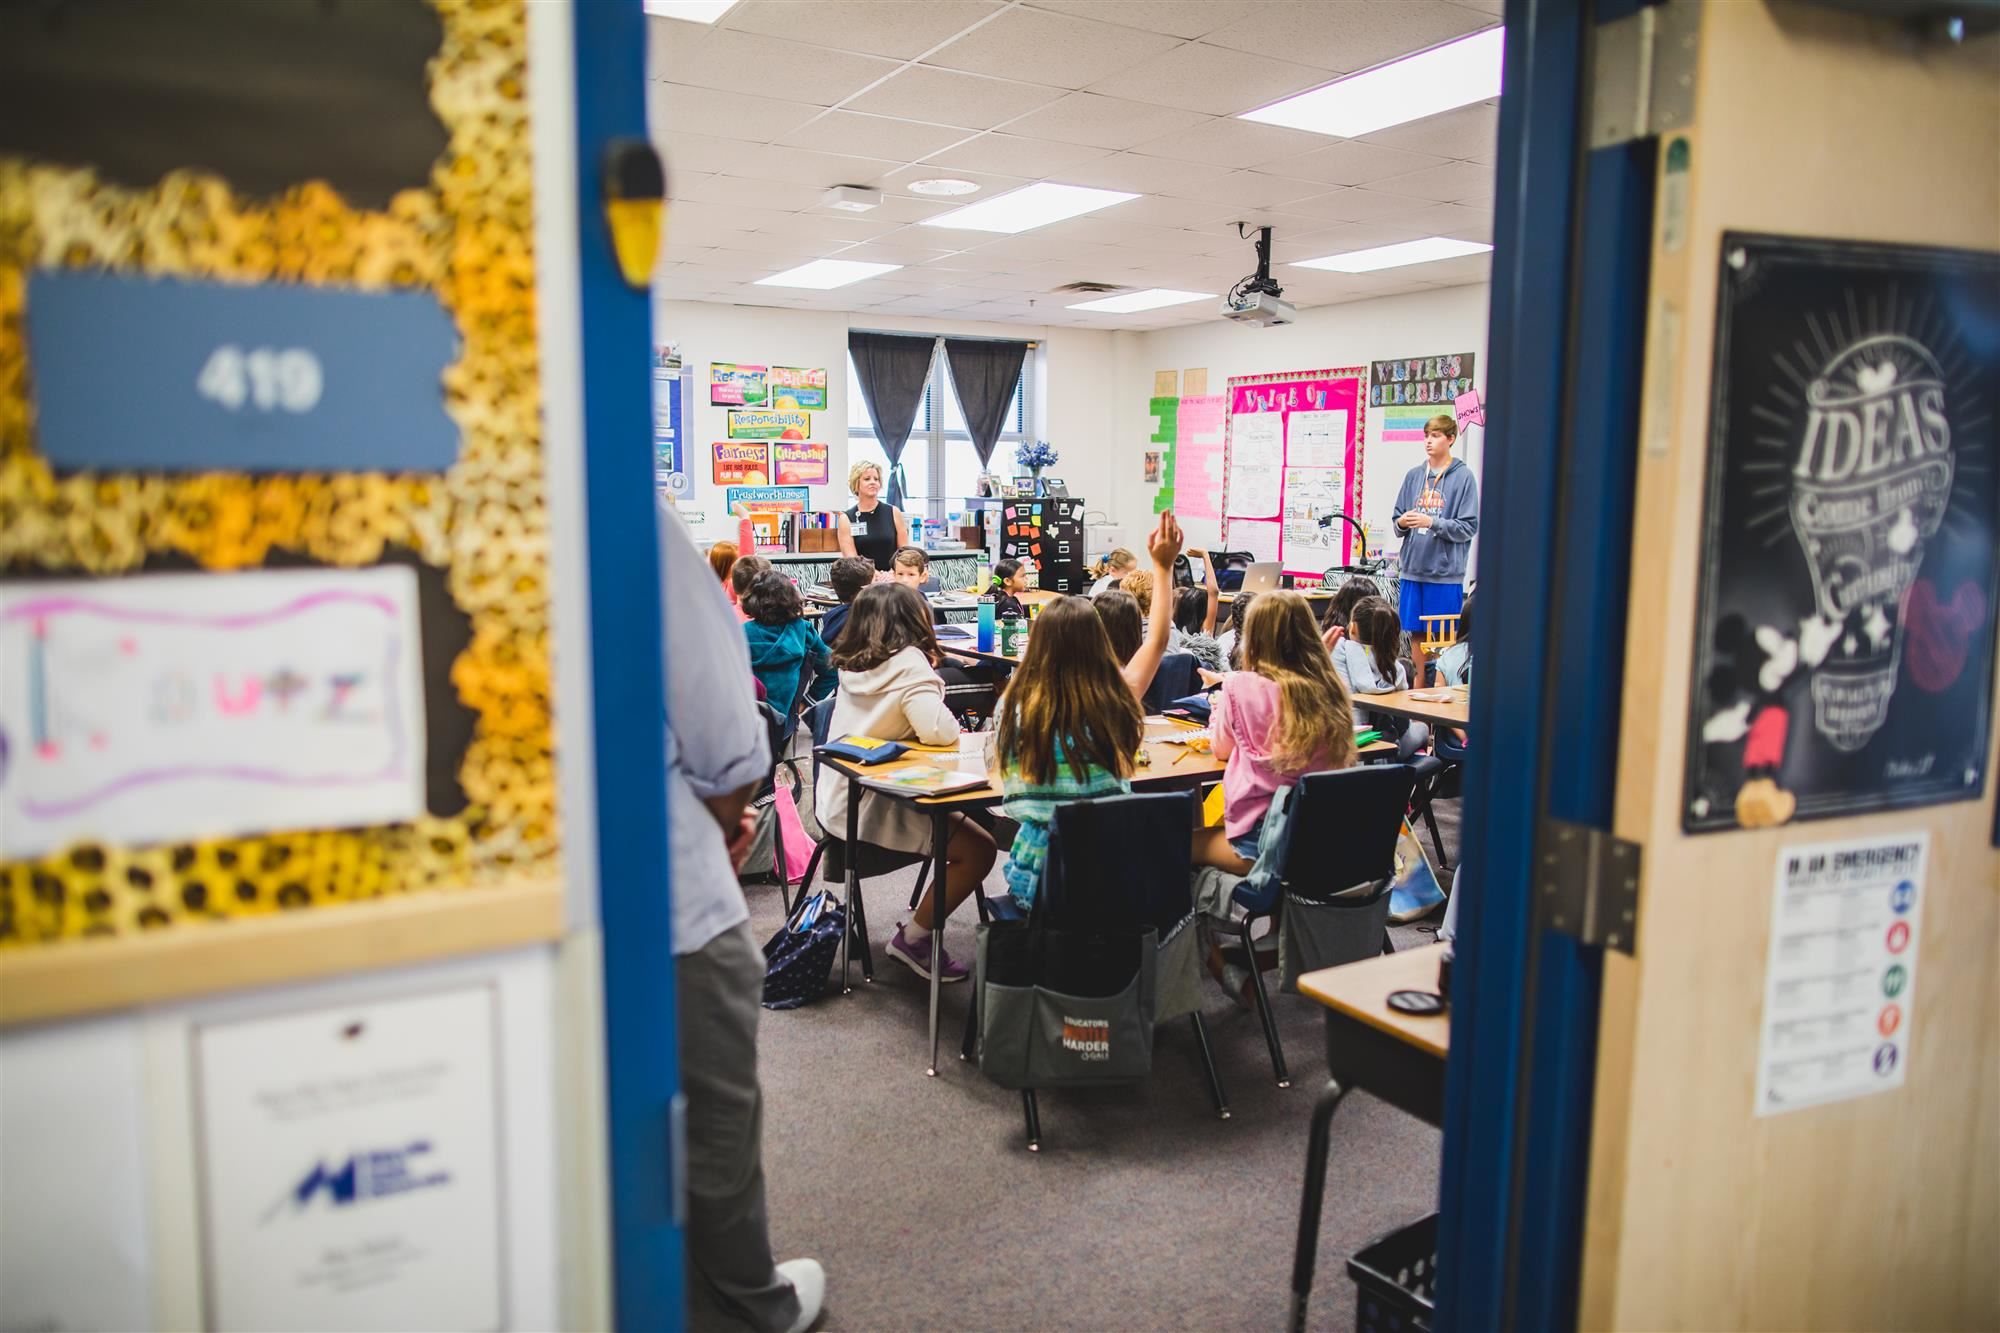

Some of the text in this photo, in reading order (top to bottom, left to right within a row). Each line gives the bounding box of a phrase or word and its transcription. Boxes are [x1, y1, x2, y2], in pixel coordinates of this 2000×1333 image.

[197, 345, 323, 412] 419
[1245, 385, 1327, 413] WRITE ON
[1371, 377, 1472, 406] CHECKLIST
[734, 414, 806, 427] Responsibility
[1793, 389, 1950, 482] IDEAS
[715, 444, 765, 460] Fairness
[775, 447, 827, 462] Citizenship
[732, 489, 805, 500] Trustworthiness
[1833, 842, 1920, 870] EMERGENCY
[1064, 1016, 1109, 1028] EDUCATORS
[1063, 1038, 1109, 1051] HARDER
